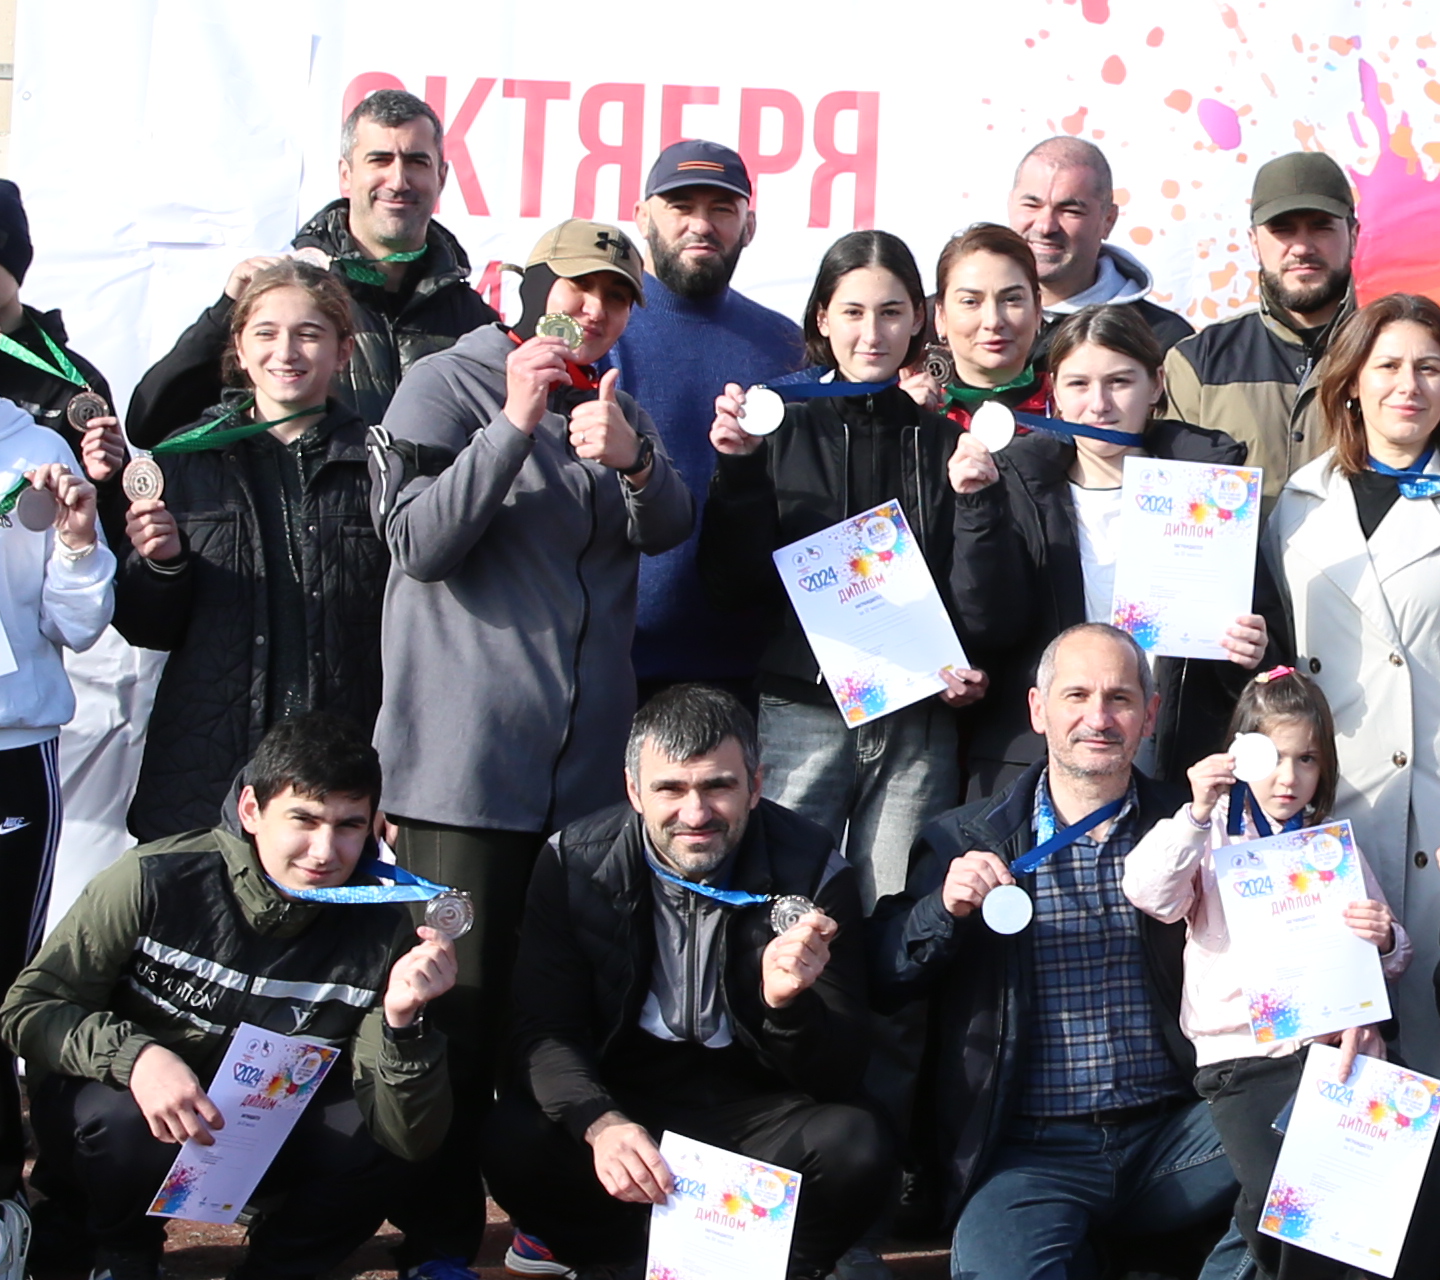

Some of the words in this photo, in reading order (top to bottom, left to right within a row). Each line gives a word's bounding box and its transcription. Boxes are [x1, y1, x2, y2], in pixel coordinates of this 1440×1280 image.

[1140, 495, 1173, 515] 2024
[1163, 522, 1214, 539] ДИПЛОМ
[803, 566, 838, 592] 2024
[838, 573, 886, 604] ДИПЛОМ
[1240, 875, 1274, 898] 2024
[1271, 893, 1322, 916] ДИПЛОМ
[235, 1064, 265, 1087] 2024
[239, 1093, 278, 1111] ДИПЛОМ
[1321, 1080, 1354, 1106] 2024
[1337, 1114, 1389, 1141] ДИПЛОМ
[695, 1207, 747, 1231] ДИПЛОМ
